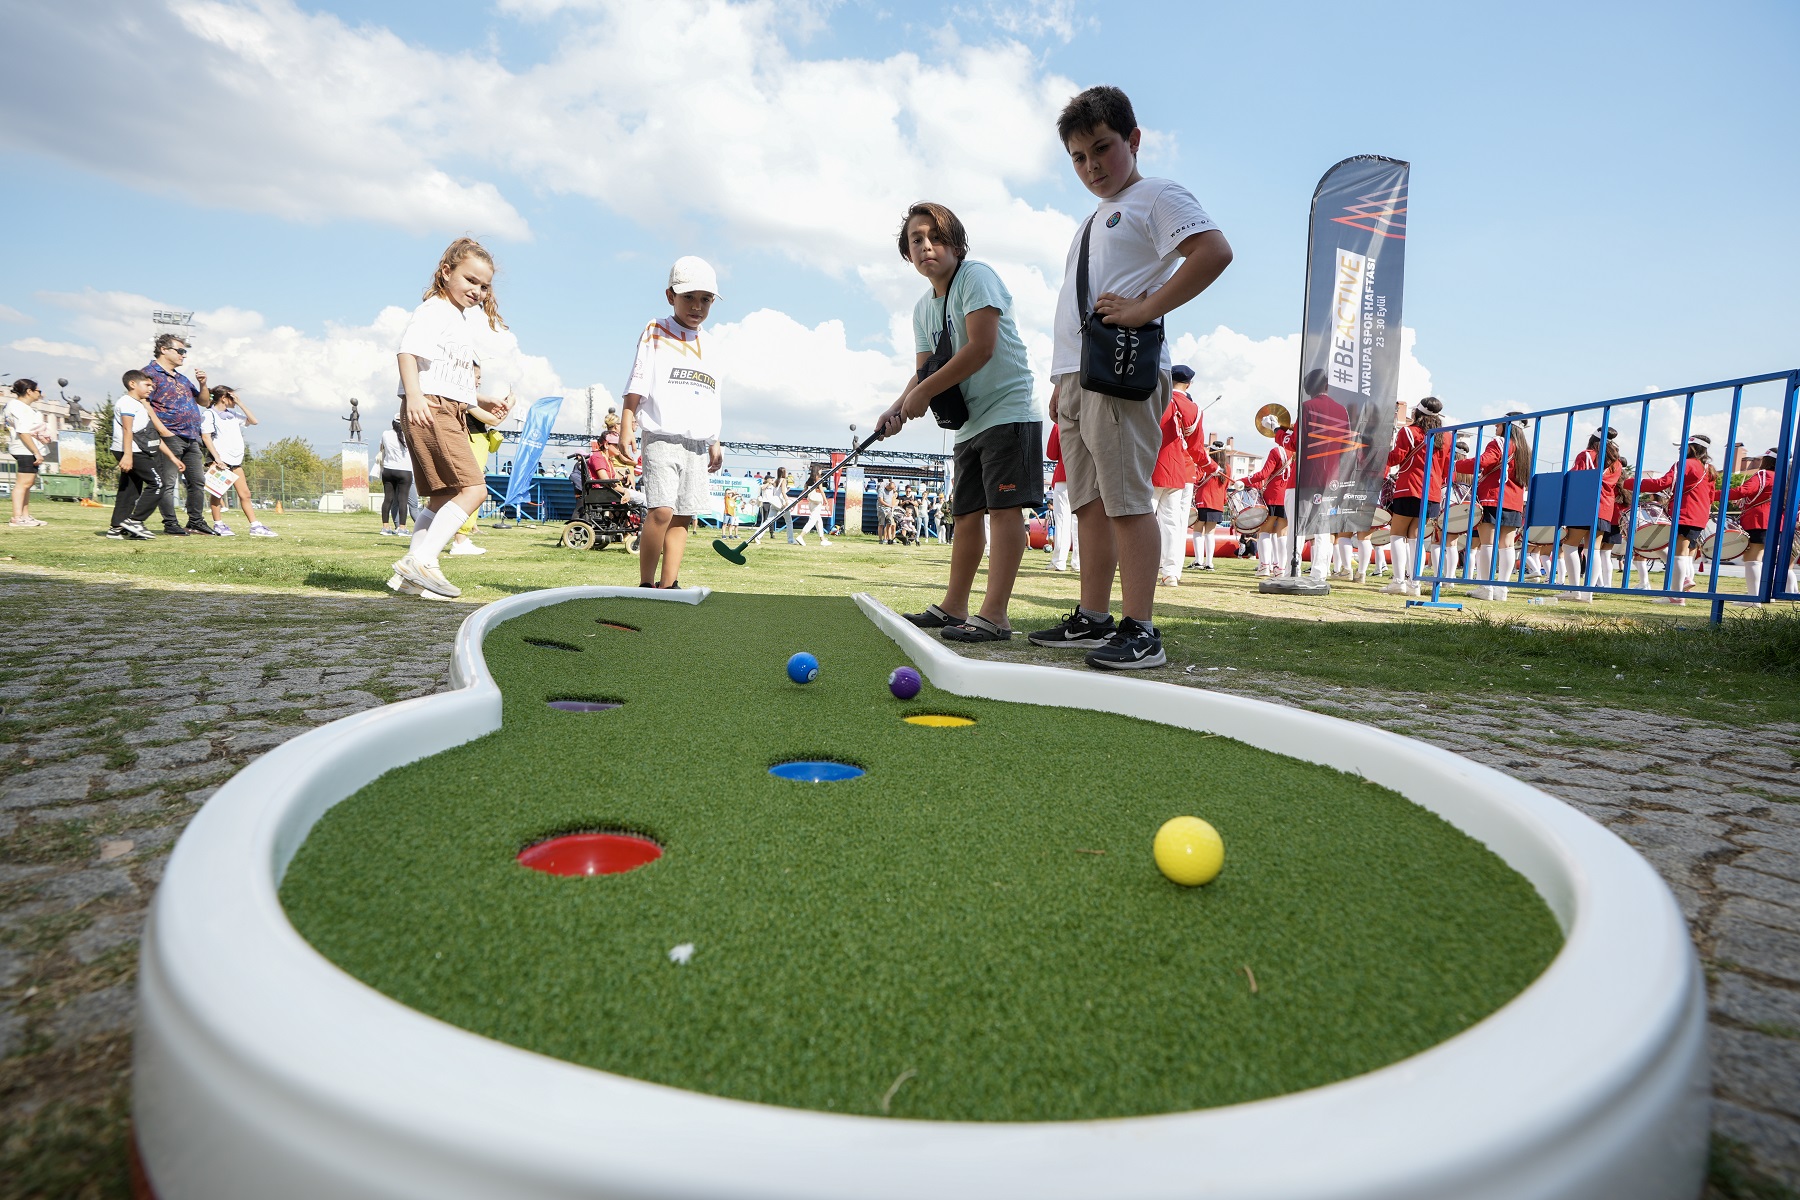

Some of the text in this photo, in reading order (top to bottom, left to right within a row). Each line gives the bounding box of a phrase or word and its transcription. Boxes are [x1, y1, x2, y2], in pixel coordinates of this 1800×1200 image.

[1170, 222, 1196, 238] WORLD
[1376, 295, 1387, 317] Eylül
[1333, 255, 1360, 384] #BEACTIVE
[1361, 257, 1376, 397] AVRUPA SPOR HAFTASI
[1376, 319, 1386, 330] 30
[1376, 337, 1385, 348] 23
[672, 368, 716, 389] #BEACTIVE
